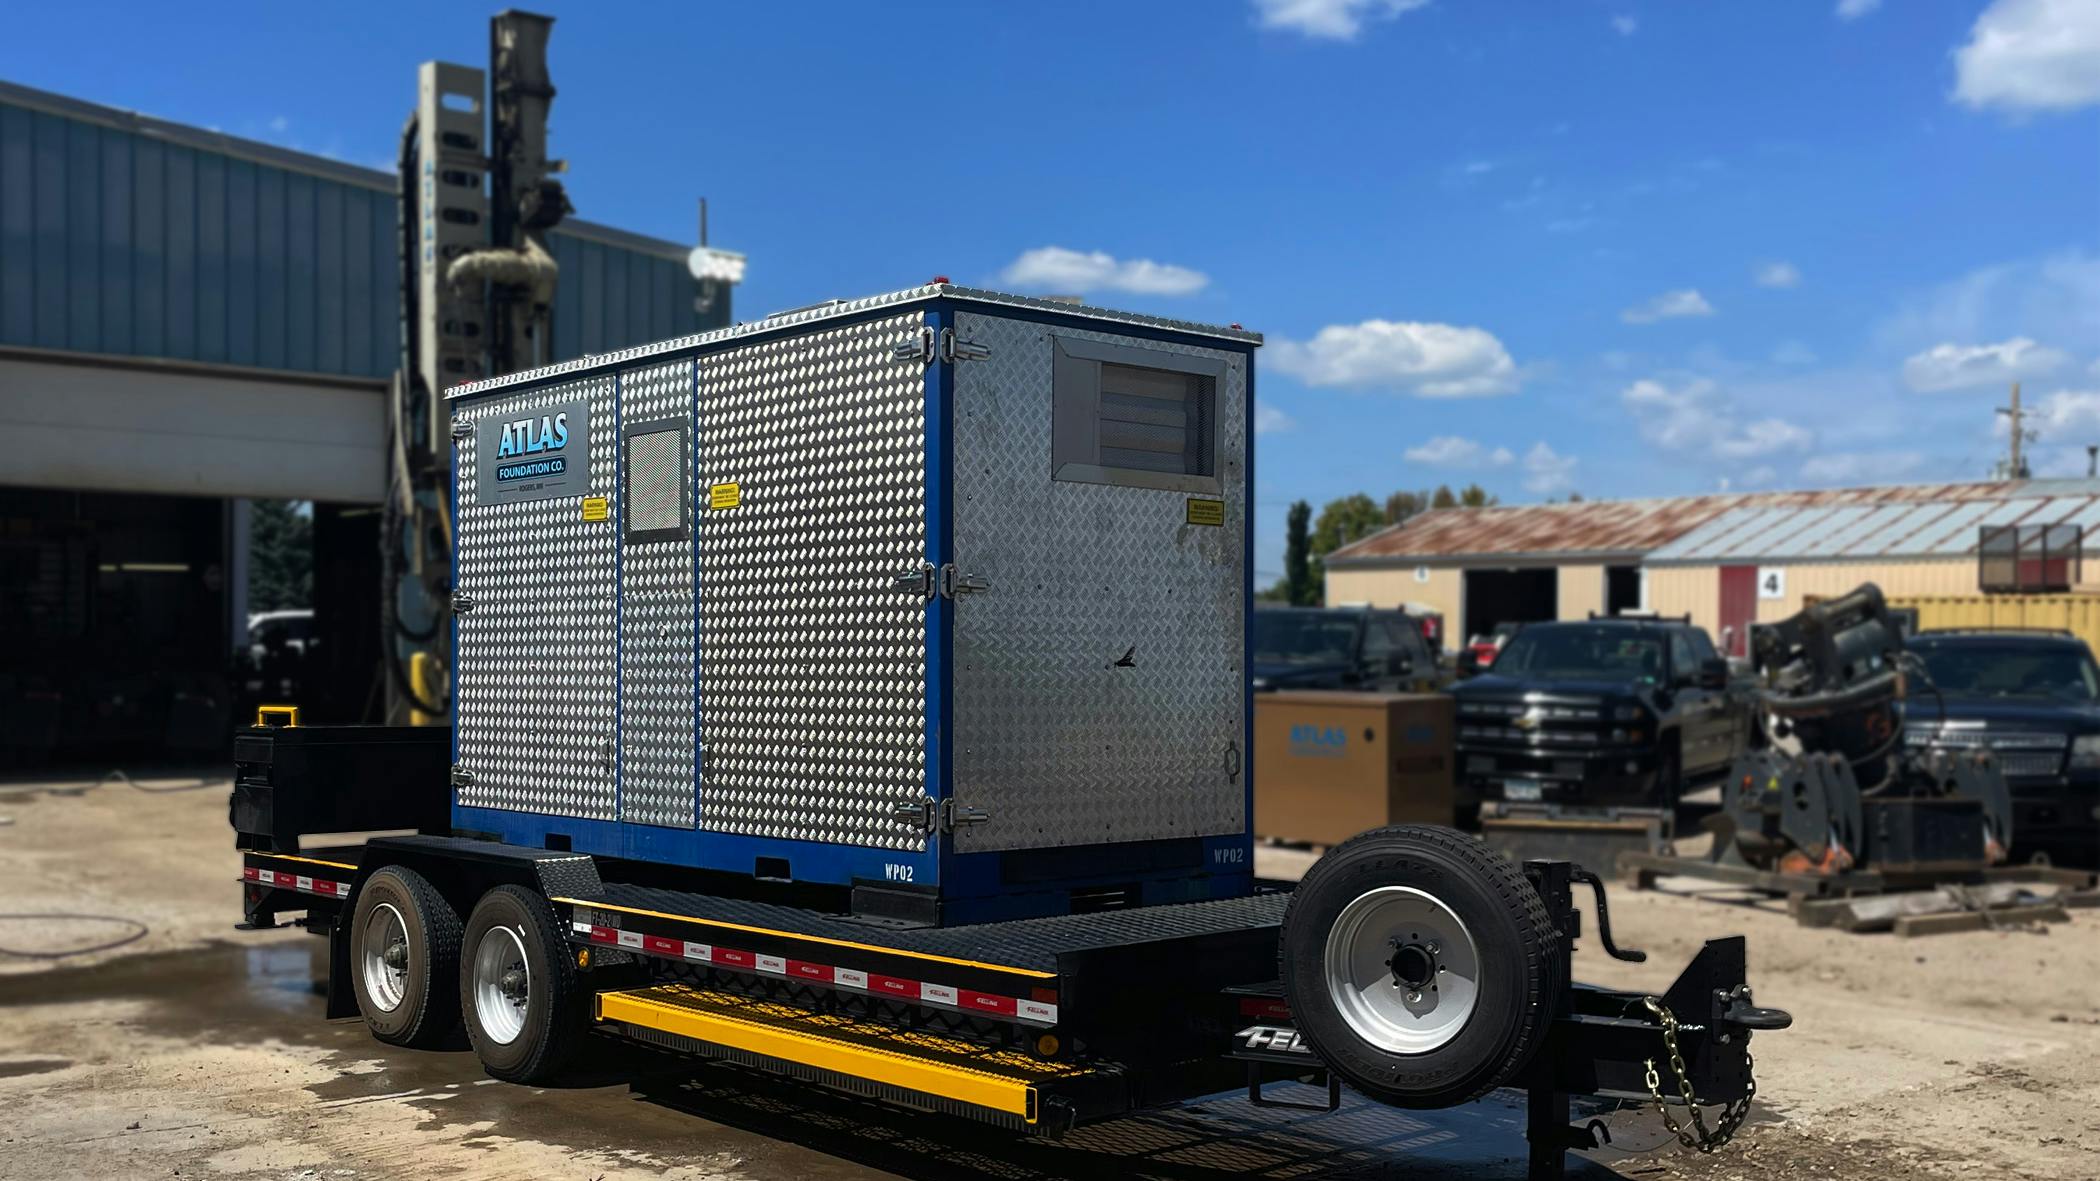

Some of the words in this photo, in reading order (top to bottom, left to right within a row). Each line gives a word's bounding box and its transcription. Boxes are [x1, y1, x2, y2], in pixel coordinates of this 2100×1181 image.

[496, 412, 568, 460] ATLAS
[499, 462, 550, 479] FOUNDATION
[550, 460, 564, 472] CO.
[1764, 573, 1778, 592] 4
[1214, 848, 1243, 864] WP02
[885, 863, 913, 882] WP02
